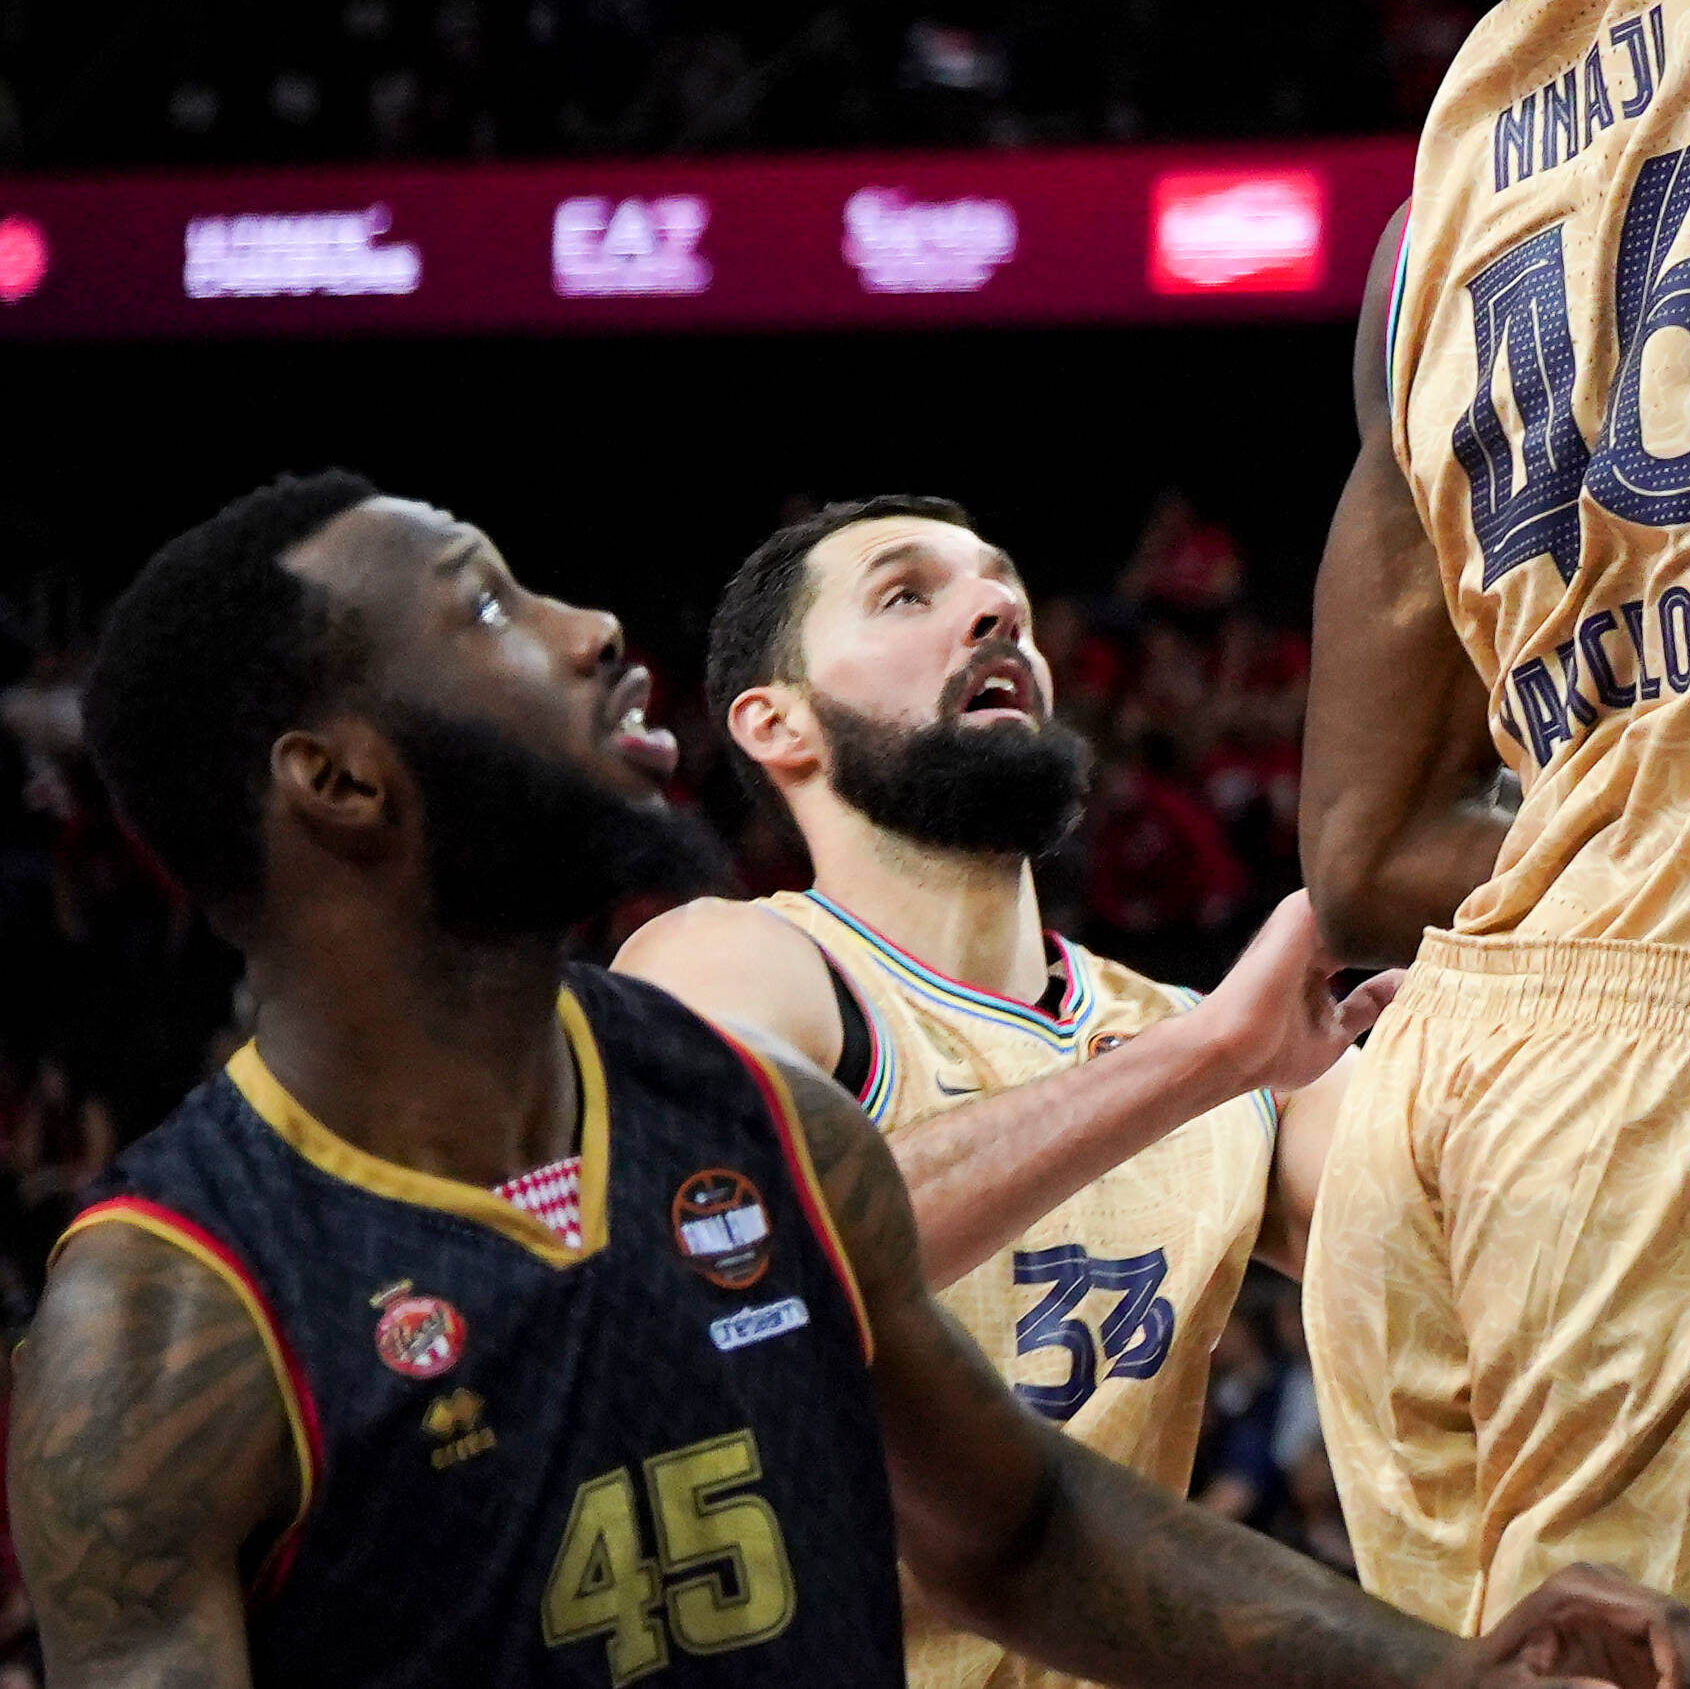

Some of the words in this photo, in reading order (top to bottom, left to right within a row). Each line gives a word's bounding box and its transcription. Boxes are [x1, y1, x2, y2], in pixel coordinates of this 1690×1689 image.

[1493, 3, 1669, 193] NNAJI
[1012, 1242, 1176, 1422] 33
[539, 1427, 798, 1689] 45
